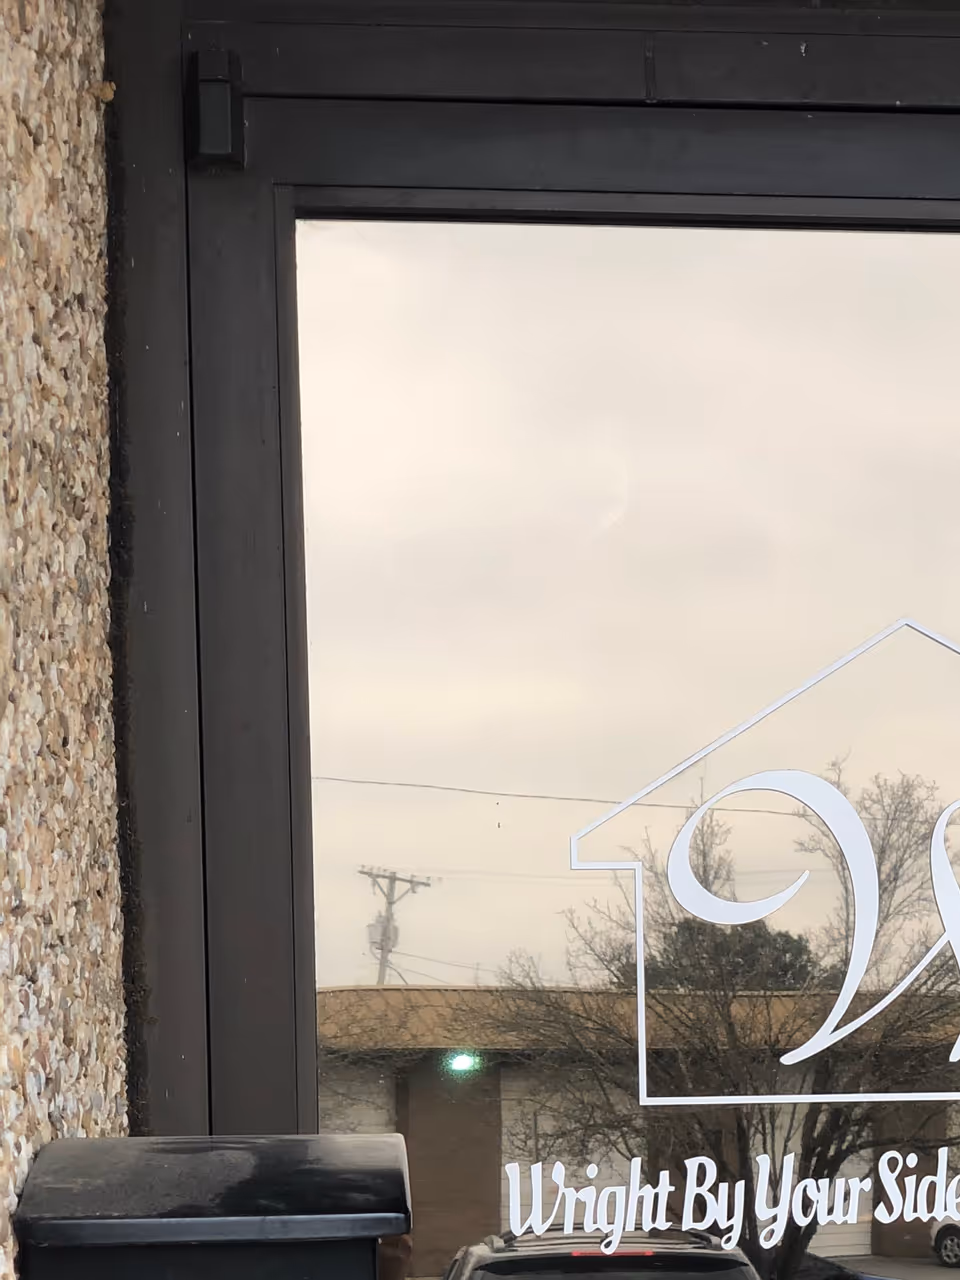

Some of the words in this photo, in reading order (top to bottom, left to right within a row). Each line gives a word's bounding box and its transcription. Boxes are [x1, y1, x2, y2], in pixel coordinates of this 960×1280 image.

[506, 1157, 676, 1253] Wright
[682, 1155, 746, 1250] By
[754, 1152, 873, 1250] Your
